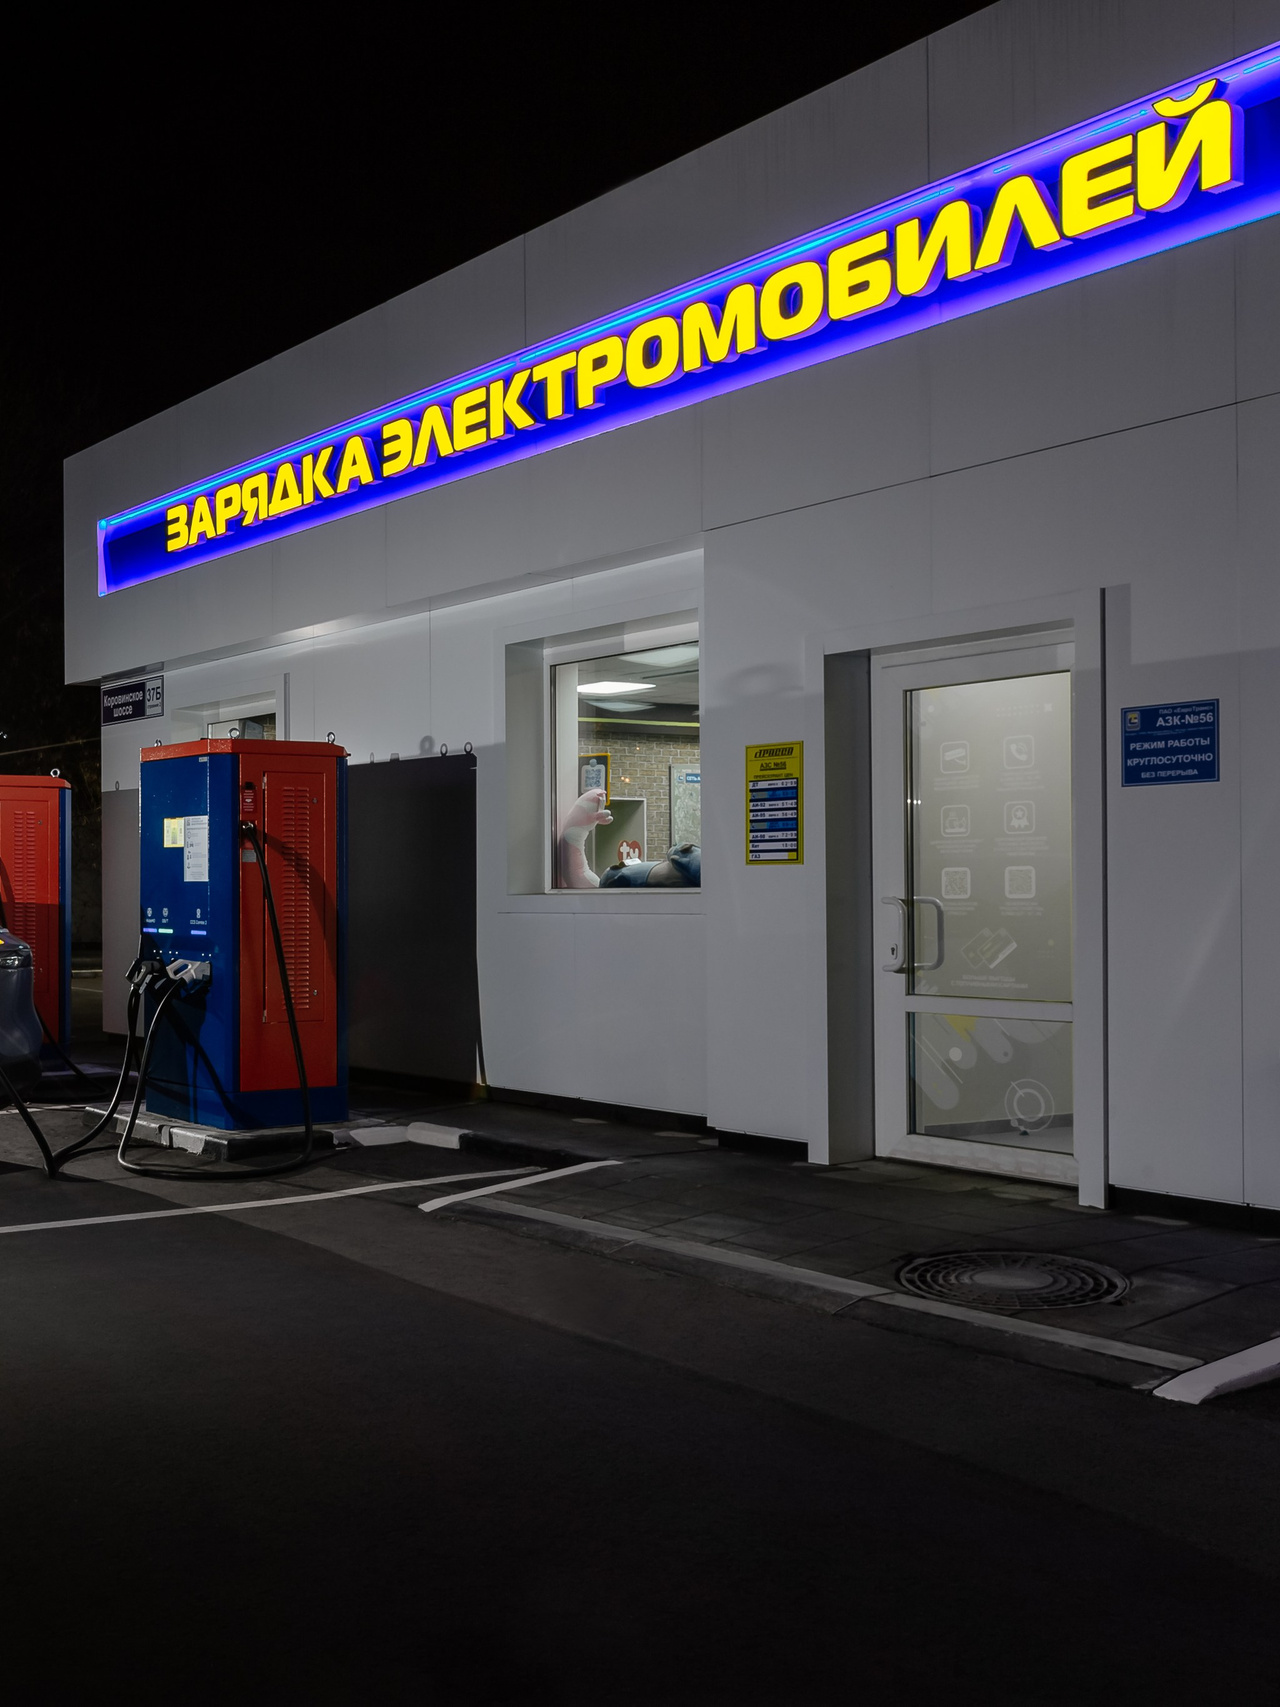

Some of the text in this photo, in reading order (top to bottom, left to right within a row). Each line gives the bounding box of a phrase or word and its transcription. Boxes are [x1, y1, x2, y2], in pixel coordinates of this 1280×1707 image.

[168, 80, 1230, 551] ЗАРЯДКА ЭЛЕКТРОМОБИЛЕЙ
[104, 691, 143, 708] Коровинское
[147, 686, 161, 702] 37Б
[114, 705, 133, 717] шоссе
[1156, 712, 1214, 727] АЗК-№56
[1129, 737, 1210, 751] РЕЖИМ РАБОТЫ
[1127, 752, 1213, 767] КРУГЛОСУТОЧНО
[1156, 768, 1198, 777] ПЕРЕРЫВА
